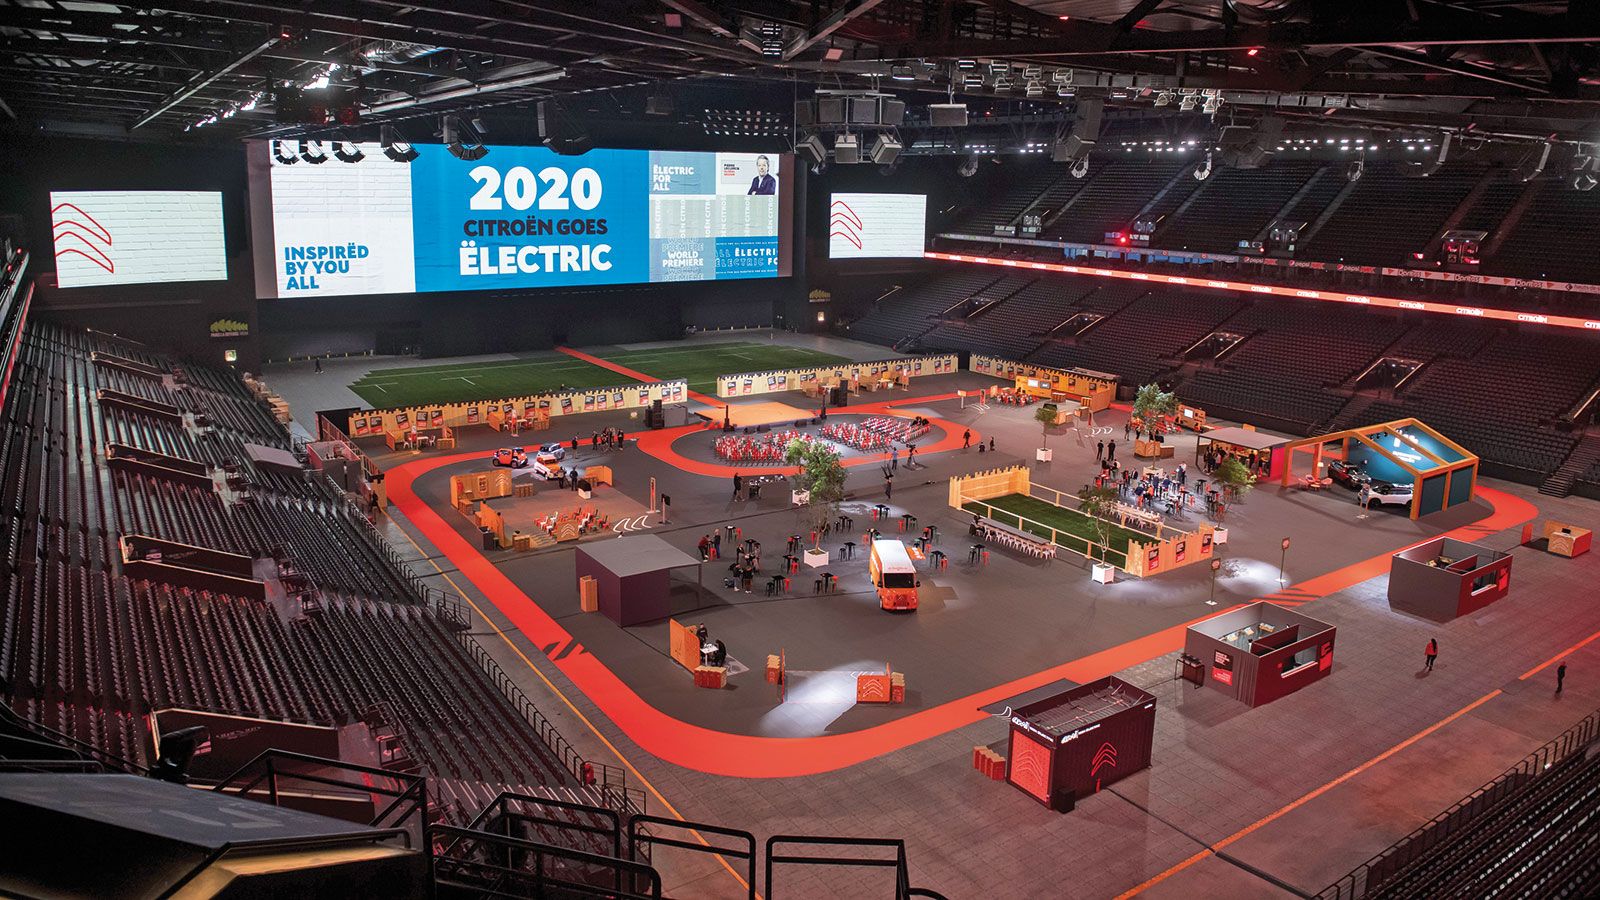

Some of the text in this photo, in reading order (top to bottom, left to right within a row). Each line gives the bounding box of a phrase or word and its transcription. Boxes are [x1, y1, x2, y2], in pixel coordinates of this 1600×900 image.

[653, 175, 671, 183] FOR
[469, 165, 603, 211] 2020
[653, 182, 670, 192] ALL
[463, 216, 608, 237] CITROËN GOES
[284, 242, 369, 261] INSPIRËD
[459, 240, 613, 277] ËLECTRIC
[667, 251, 699, 259] WORLD
[734, 247, 778, 257] ËLECTRI
[285, 259, 350, 275] BY YOU
[662, 258, 704, 268] PREMIERE
[286, 275, 320, 290] ALL
